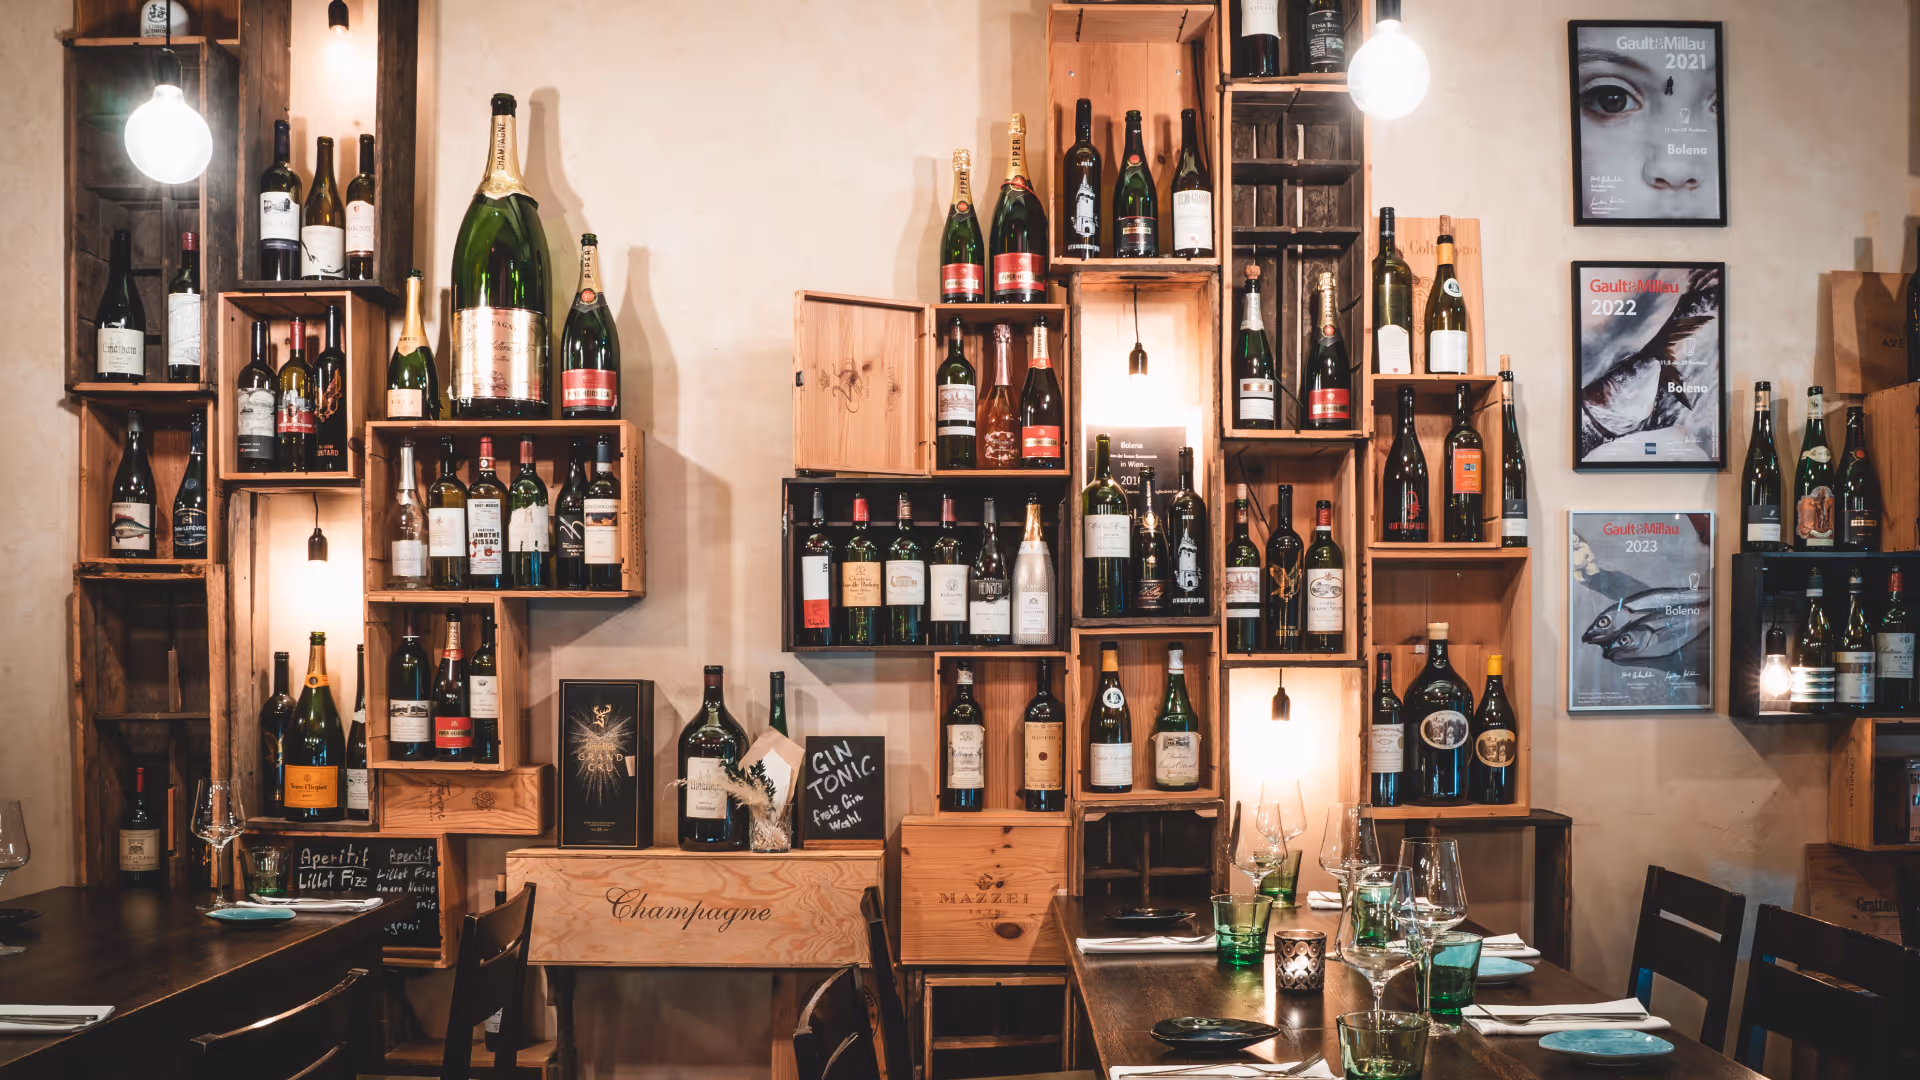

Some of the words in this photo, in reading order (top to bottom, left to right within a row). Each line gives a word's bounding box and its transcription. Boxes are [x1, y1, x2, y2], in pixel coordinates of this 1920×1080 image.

[1665, 54, 1706, 69] 2021
[496, 122, 506, 170] CHAMPAGNE
[1012, 138, 1021, 166] PIPER
[1668, 144, 1708, 155] Bolena
[584, 250, 592, 279] PIPER
[1591, 299, 1637, 316] 2022
[1668, 382, 1708, 393] Bolena
[1625, 540, 1657, 553] 2023
[978, 582, 1002, 595] HEINRICH
[1665, 605, 1700, 616] Bolena
[812, 740, 853, 775] GIN
[588, 763, 613, 771] CRU
[841, 793, 863, 810] Gin
[829, 810, 862, 832] Wahl
[301, 844, 368, 869] Aperitif
[390, 846, 433, 866] Aperitif
[299, 871, 334, 889] Lillet
[341, 870, 367, 890] Fizz
[377, 868, 408, 880] Lillet
[414, 867, 436, 878] Fizz
[416, 896, 436, 910] onic
[938, 893, 1032, 904] MAZZEI
[606, 887, 772, 933] Champagne
[384, 920, 420, 935] groni
